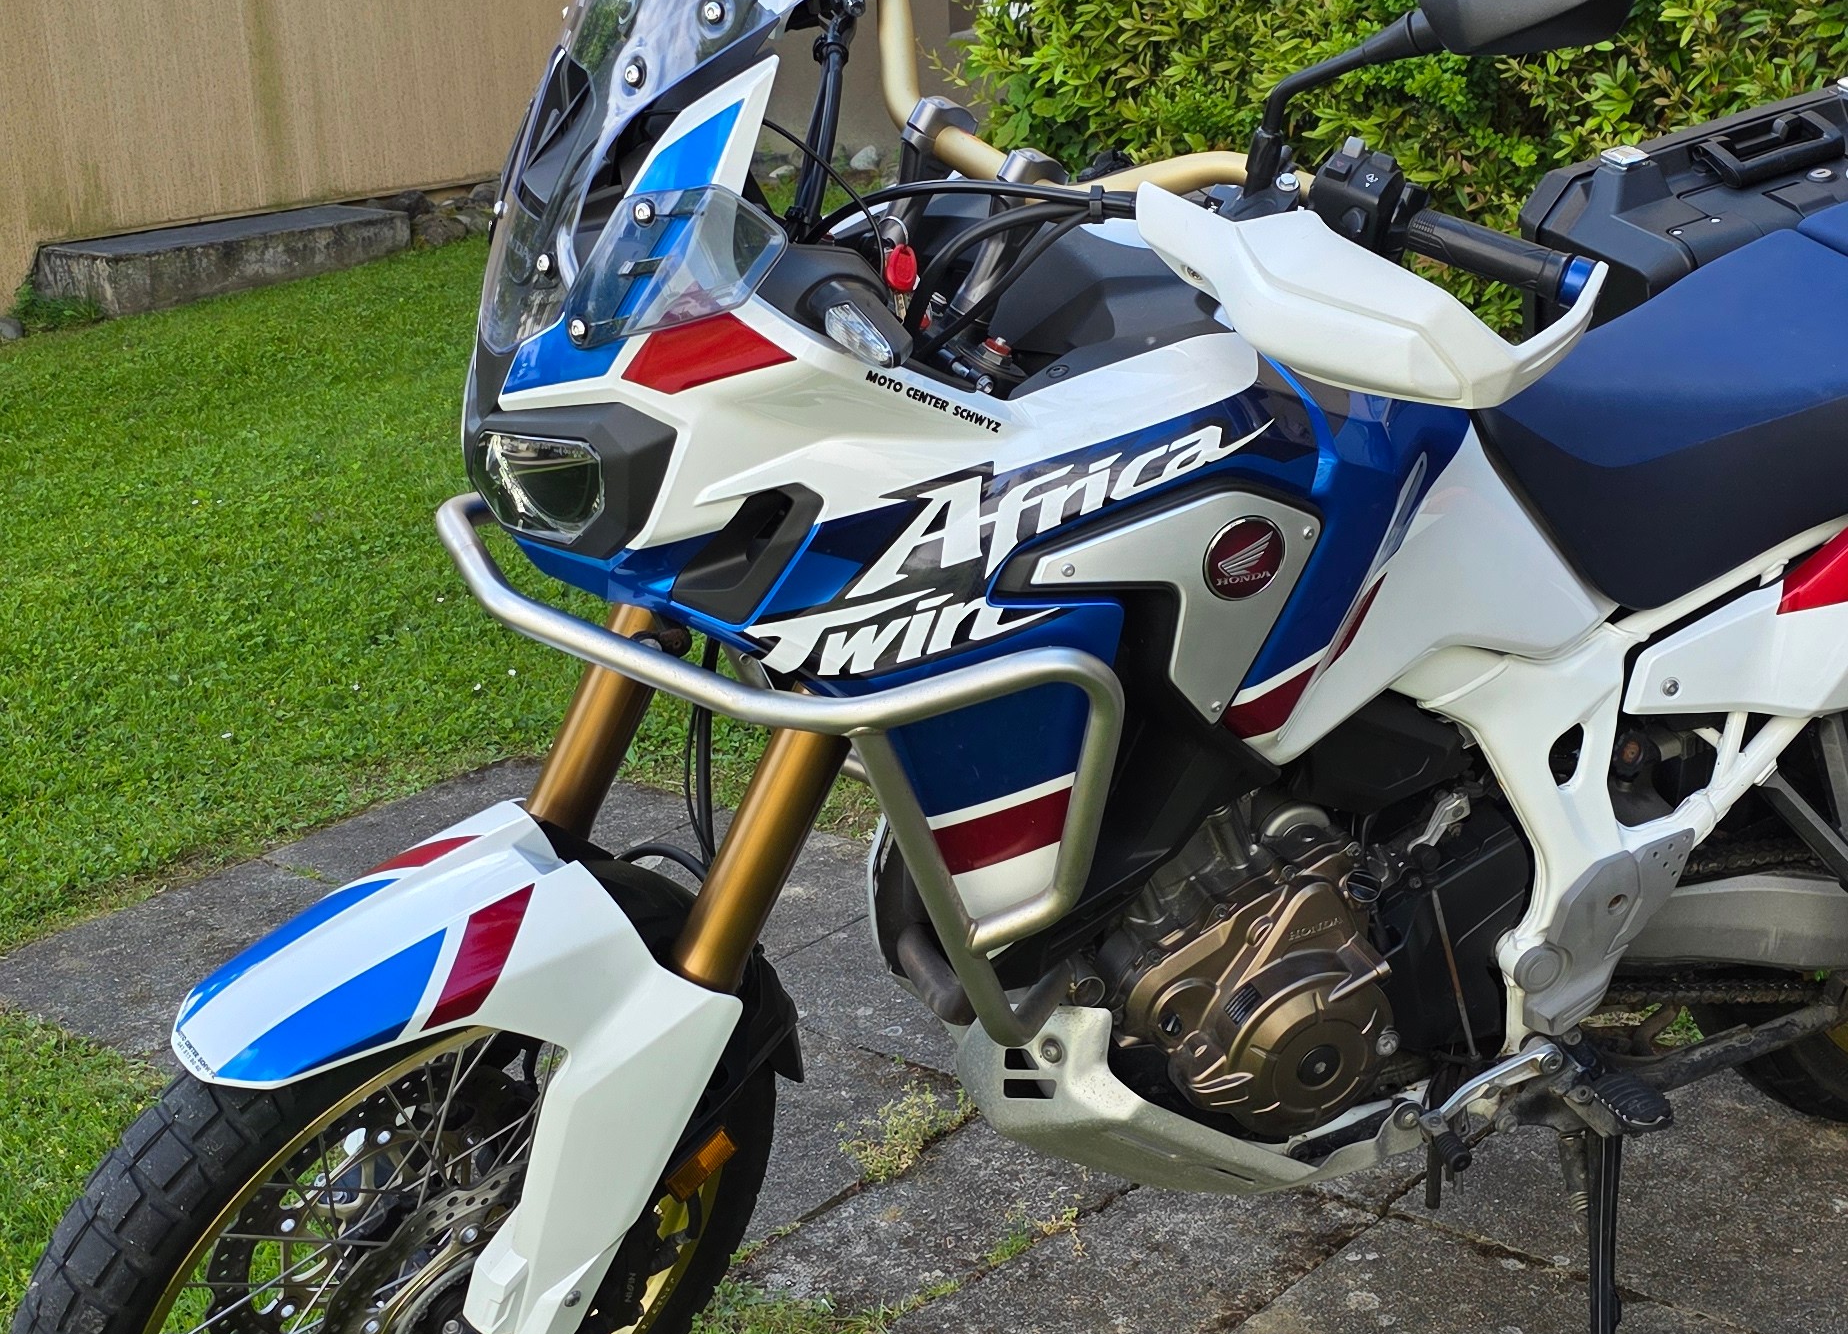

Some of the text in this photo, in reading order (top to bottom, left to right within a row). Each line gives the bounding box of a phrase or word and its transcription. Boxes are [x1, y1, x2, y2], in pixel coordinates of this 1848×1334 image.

[865, 370, 1002, 433] MOTO CENTER SCHWYZ
[845, 418, 1275, 600] Africa
[1216, 570, 1272, 586] HONDA
[743, 588, 1060, 676] Twin
[1288, 917, 1344, 942] HONDA
